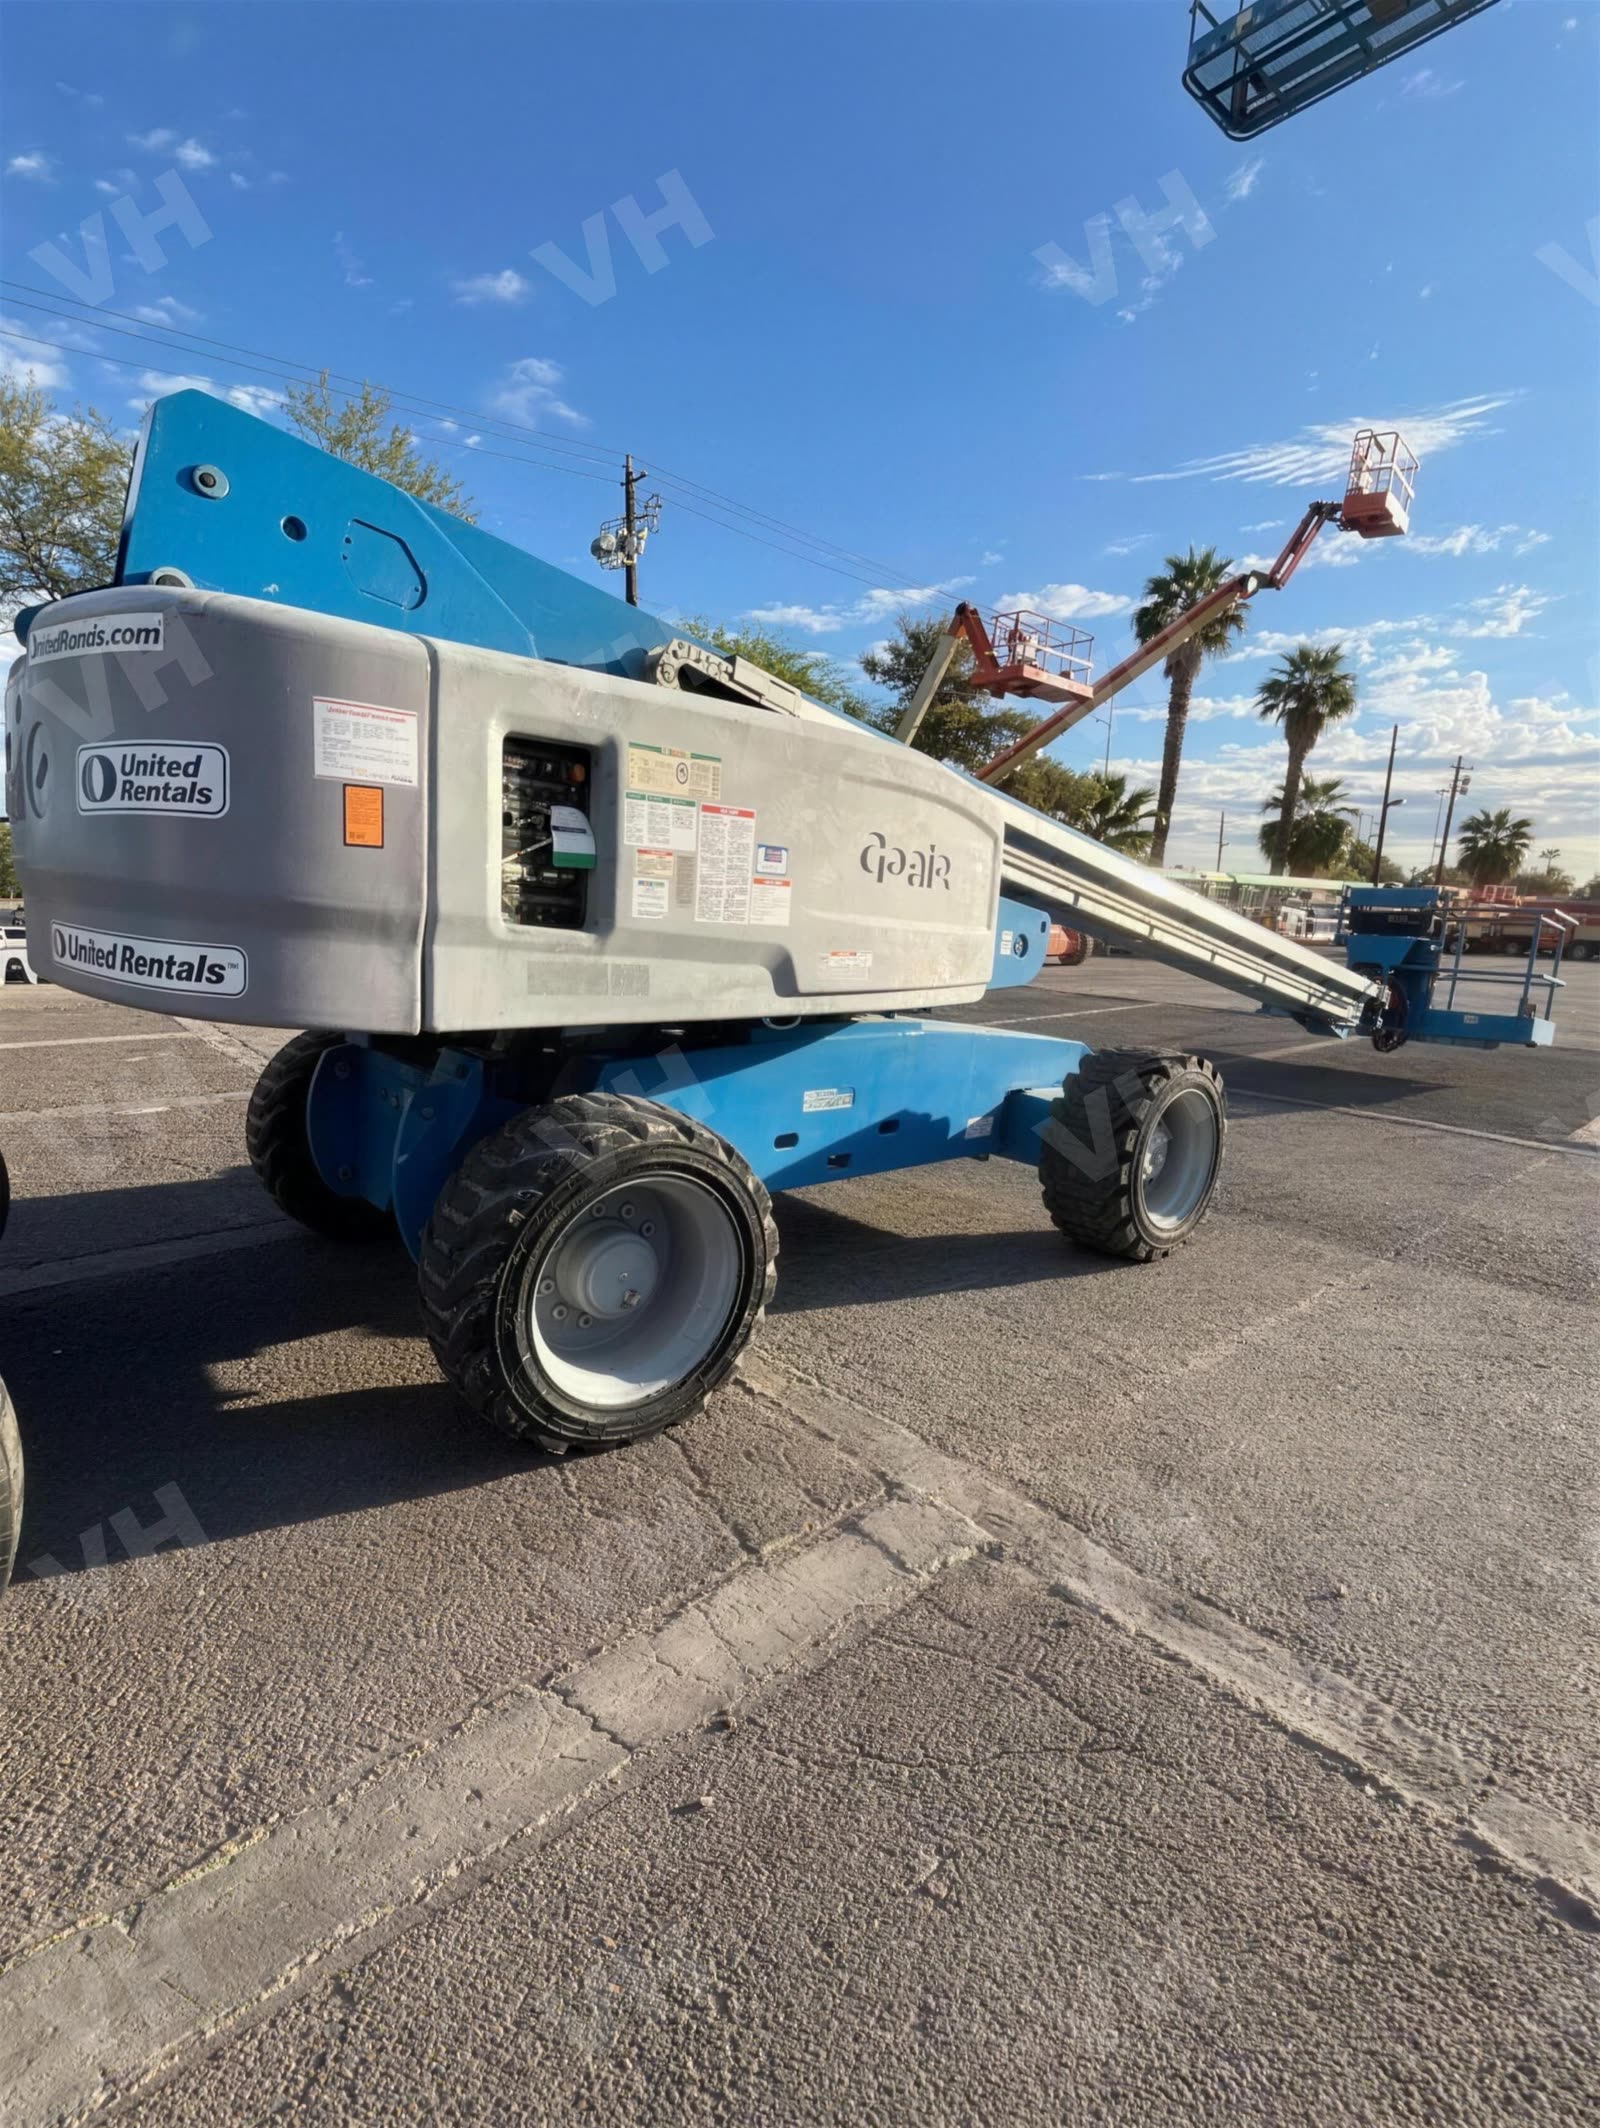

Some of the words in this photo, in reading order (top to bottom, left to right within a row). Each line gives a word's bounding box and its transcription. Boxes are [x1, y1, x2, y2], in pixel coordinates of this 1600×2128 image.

[120, 753, 202, 778] United
[120, 779, 213, 805] Rentals
[68, 934, 117, 970] United
[120, 945, 226, 985] Rentals
